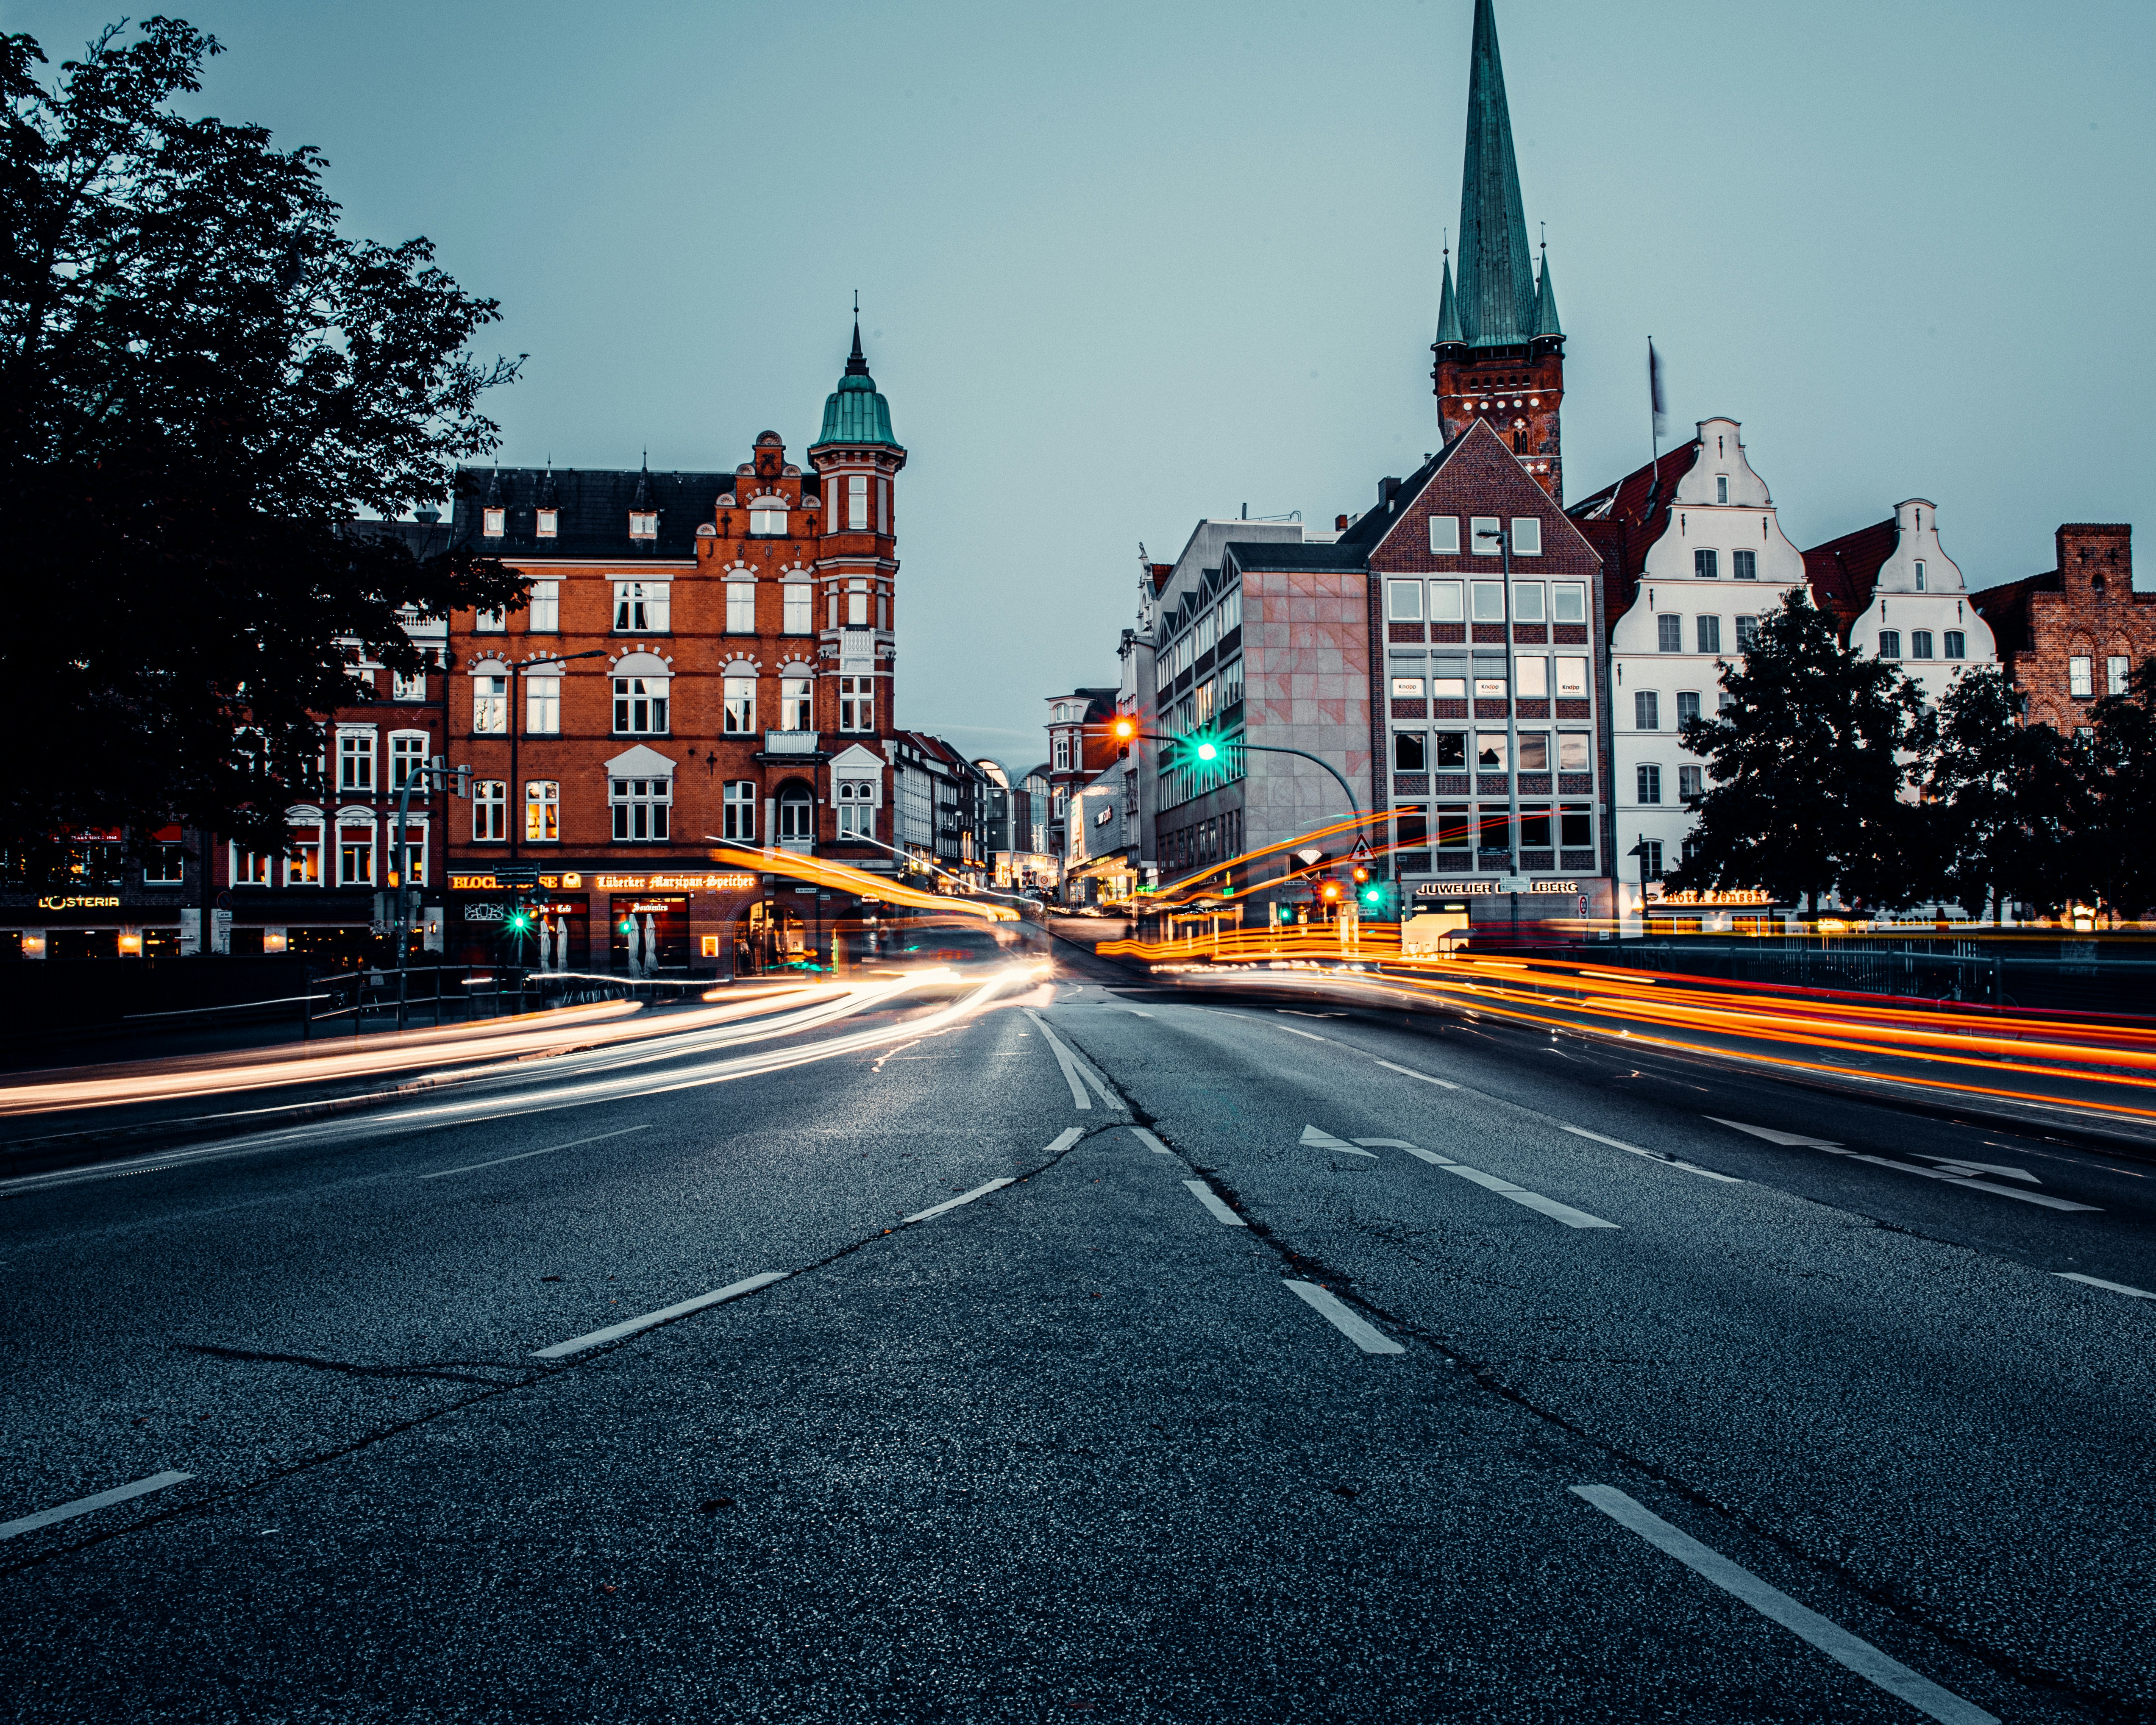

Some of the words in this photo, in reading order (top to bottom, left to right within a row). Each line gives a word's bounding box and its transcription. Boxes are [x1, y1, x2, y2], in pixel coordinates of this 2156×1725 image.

[597, 876, 645, 888] Lübecker
[649, 874, 754, 888] Marzipan-Speicher
[1417, 883, 1492, 894] JUWELIER
[633, 902, 668, 913] Souvenirs
